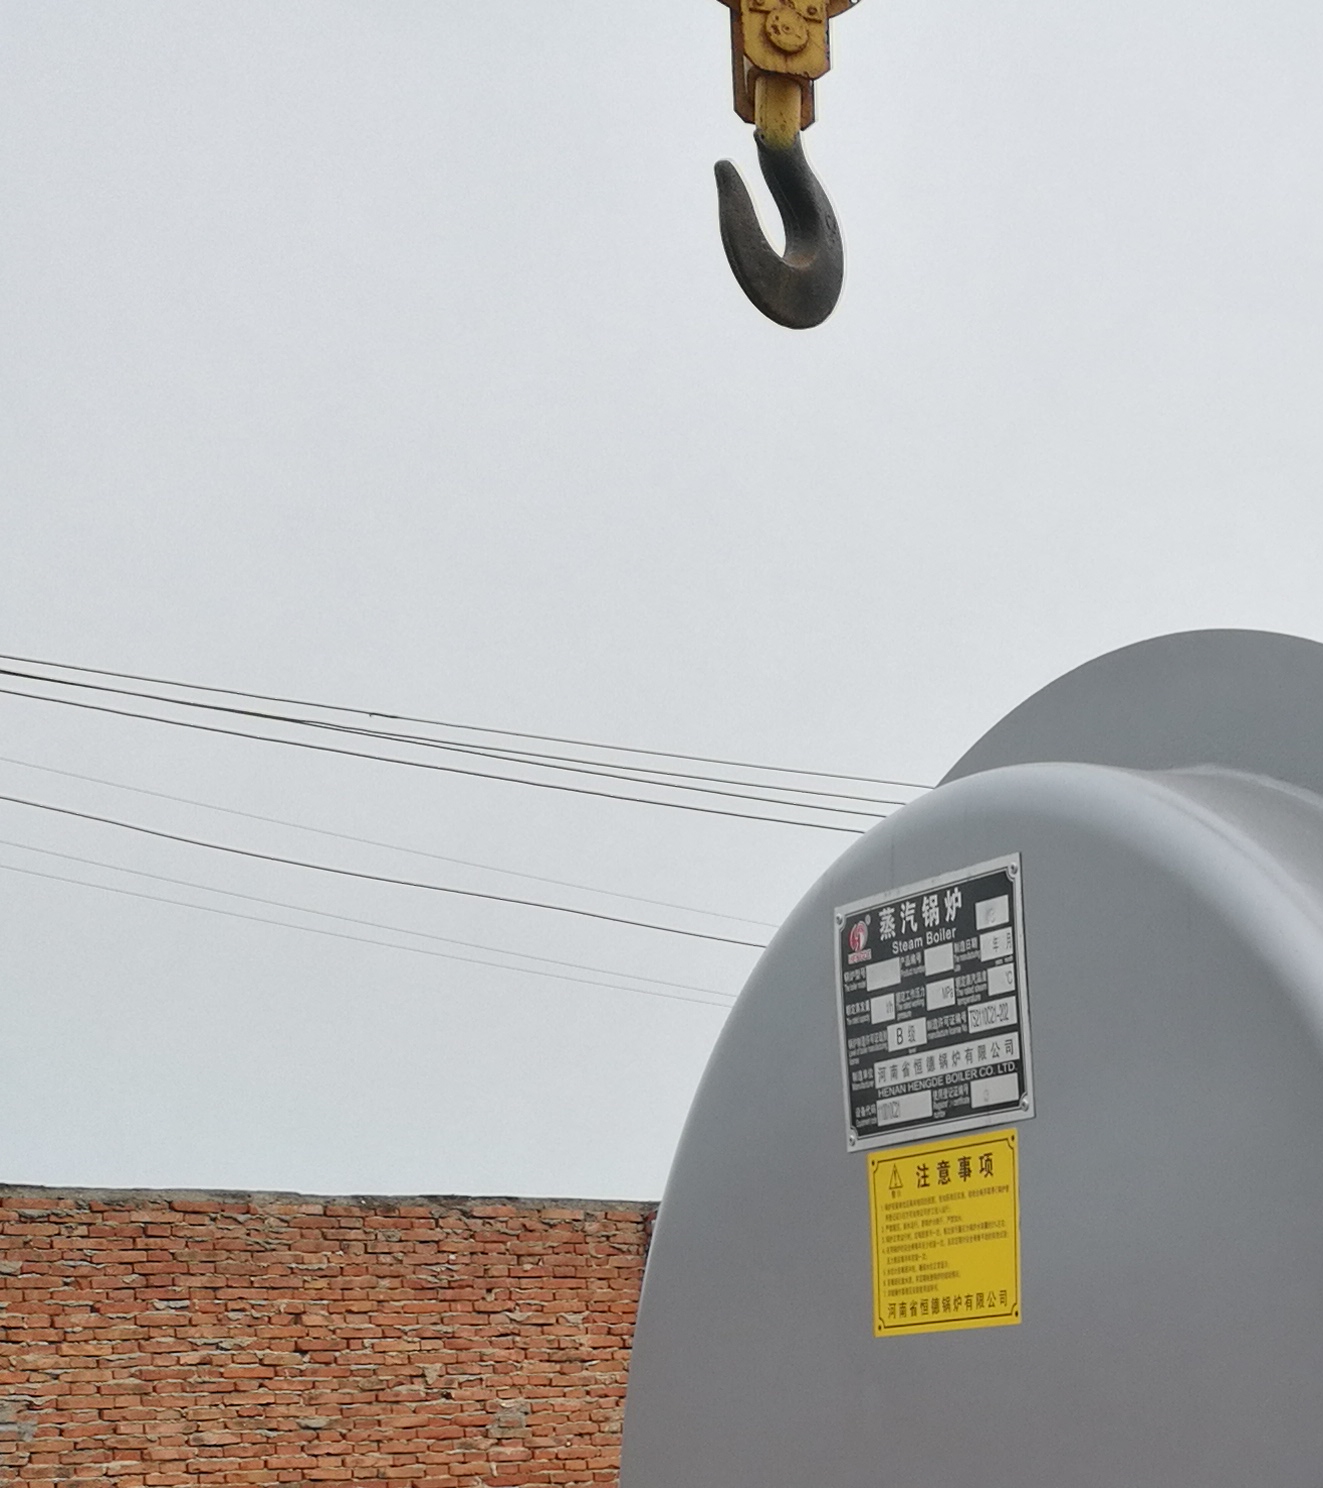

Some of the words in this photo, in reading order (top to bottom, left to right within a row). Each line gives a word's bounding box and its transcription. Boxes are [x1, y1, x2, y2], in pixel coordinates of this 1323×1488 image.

[878, 887, 962, 941] 蒸汽锅炉
[892, 936, 923, 954] Steam
[926, 927, 956, 945] Boiler
[877, 1038, 1014, 1083] 河南省恒德锅炉有限公司
[878, 1084, 907, 1098] HENAN
[907, 1076, 944, 1092] HENGDE
[945, 1068, 979, 1085] BOILER
[916, 1152, 994, 1188] 注意事项
[887, 1289, 1008, 1319] 河南省恒德锅炉有限公司
